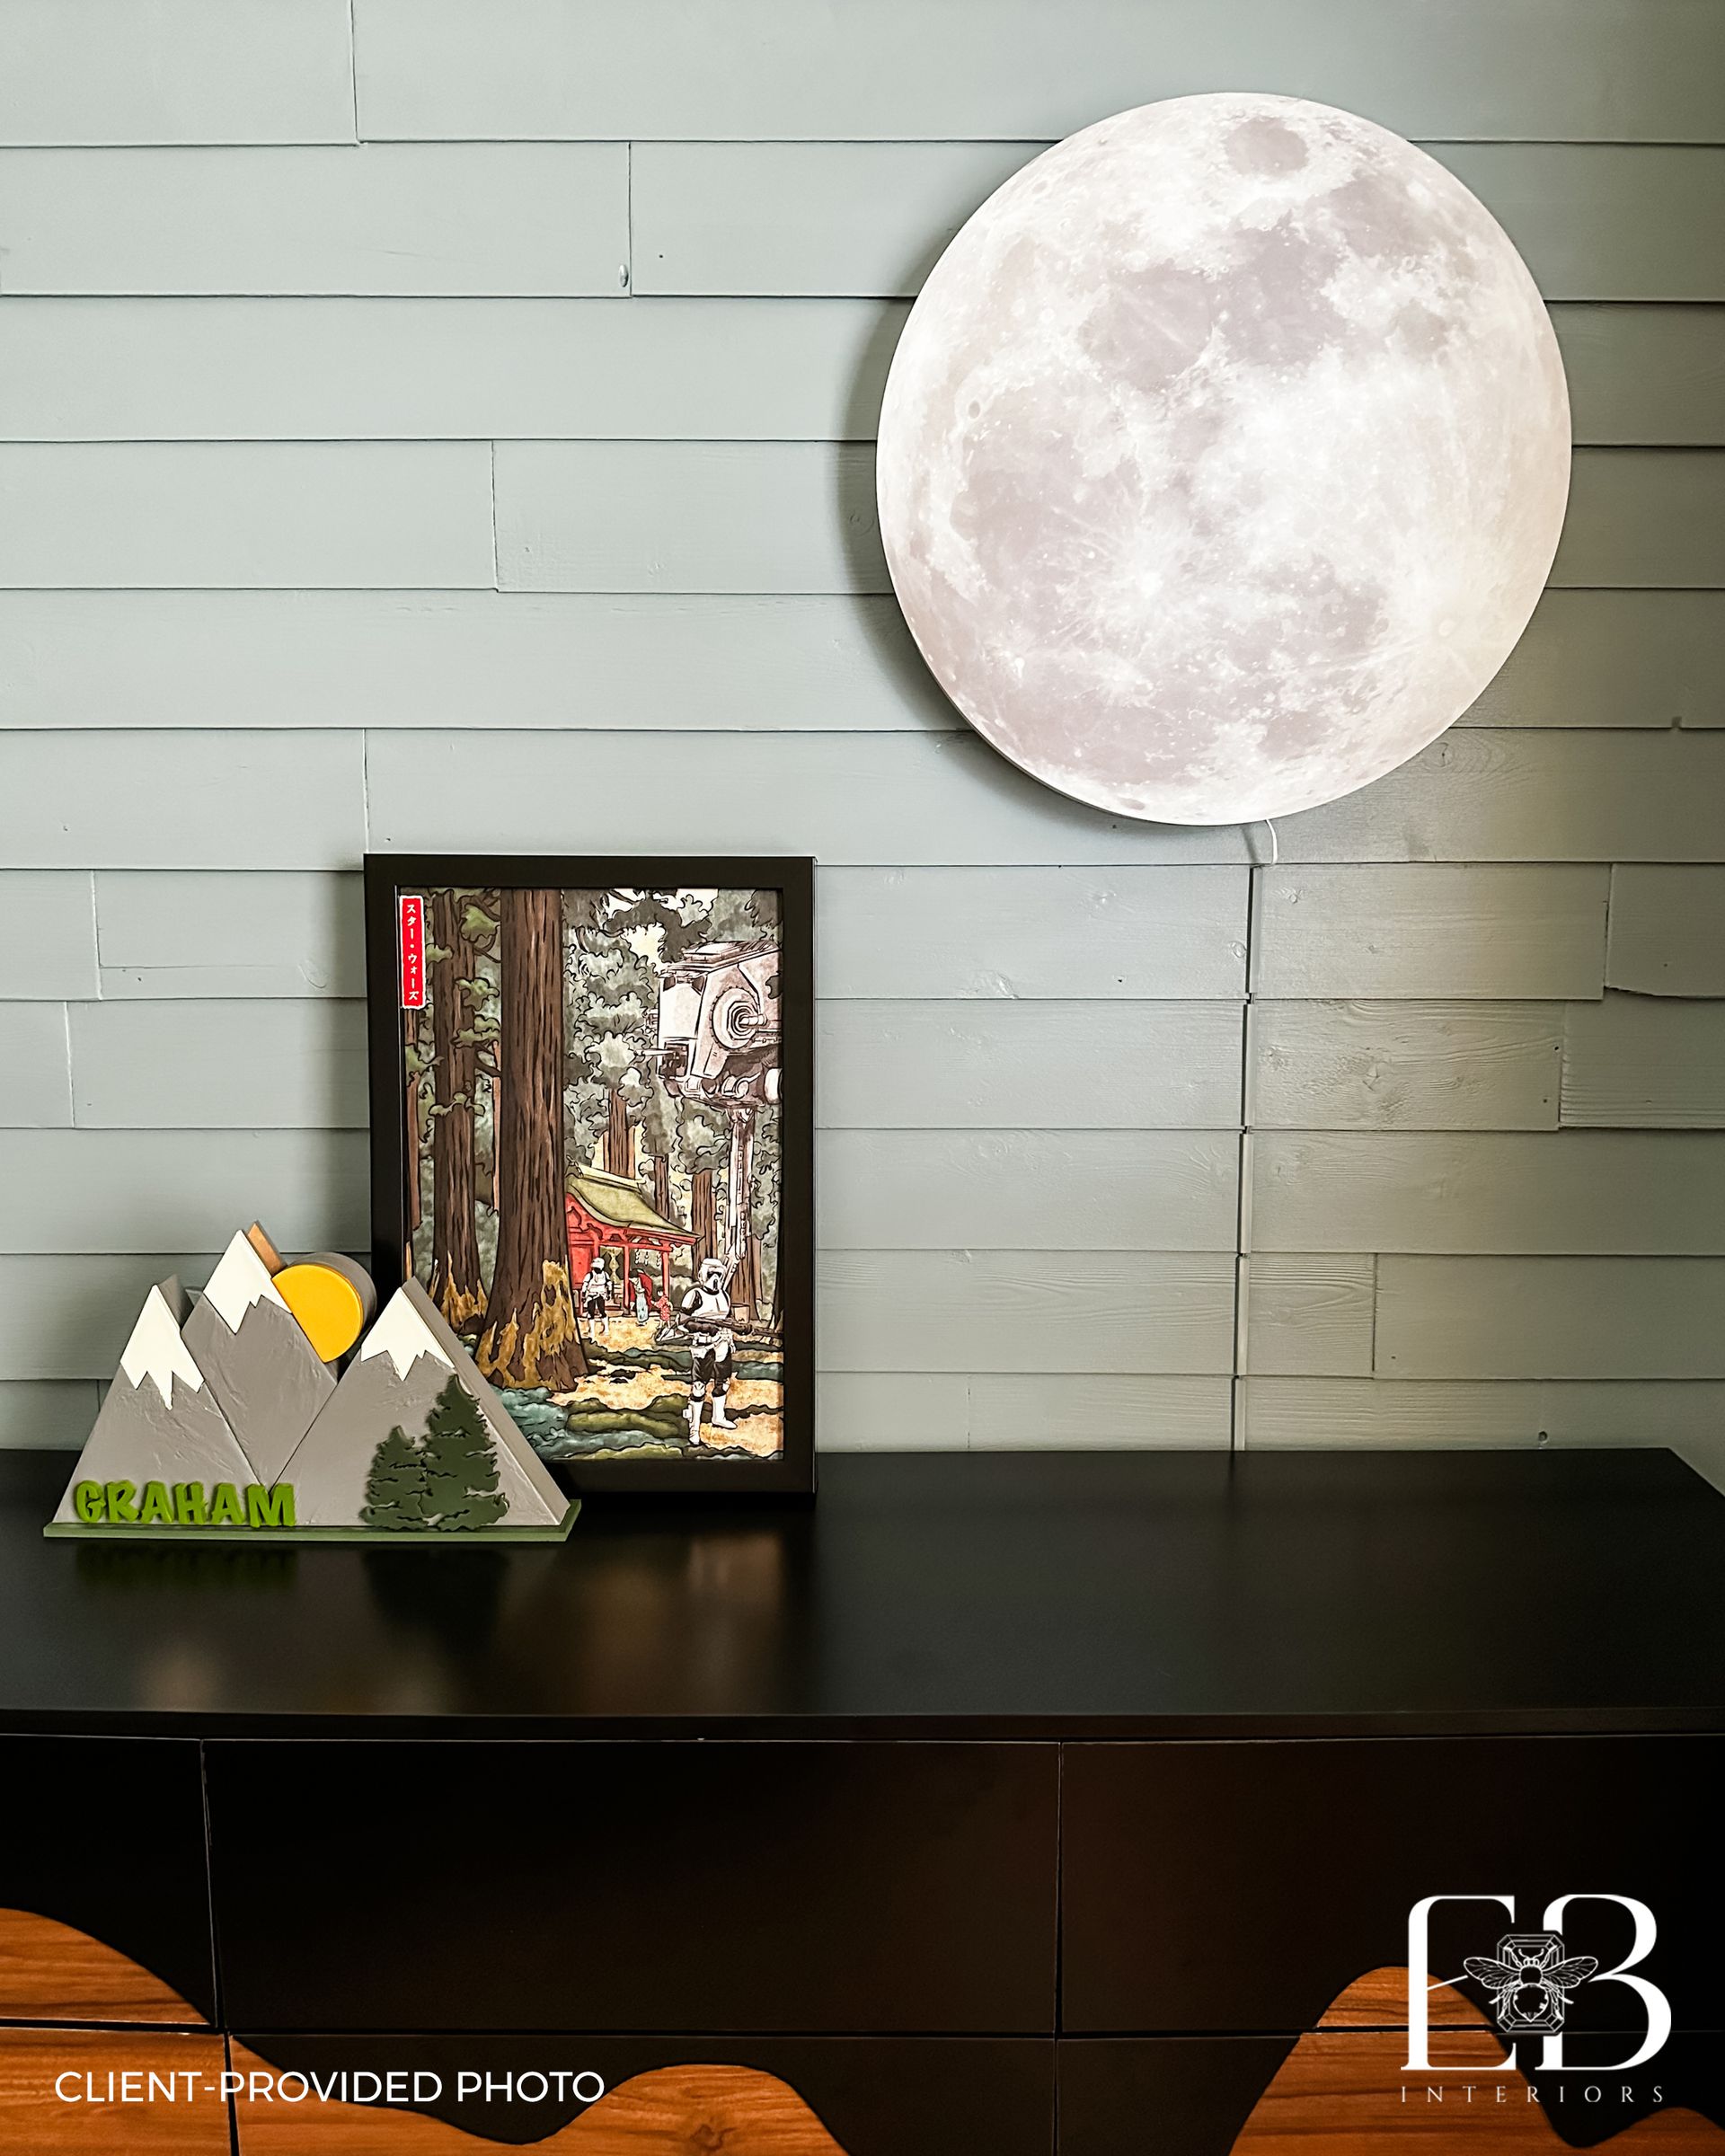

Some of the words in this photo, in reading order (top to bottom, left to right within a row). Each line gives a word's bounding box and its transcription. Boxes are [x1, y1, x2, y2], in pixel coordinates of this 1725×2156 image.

[406, 904, 420, 1000] スター・ウォーズ
[74, 1480, 296, 1527] GRAHAM
